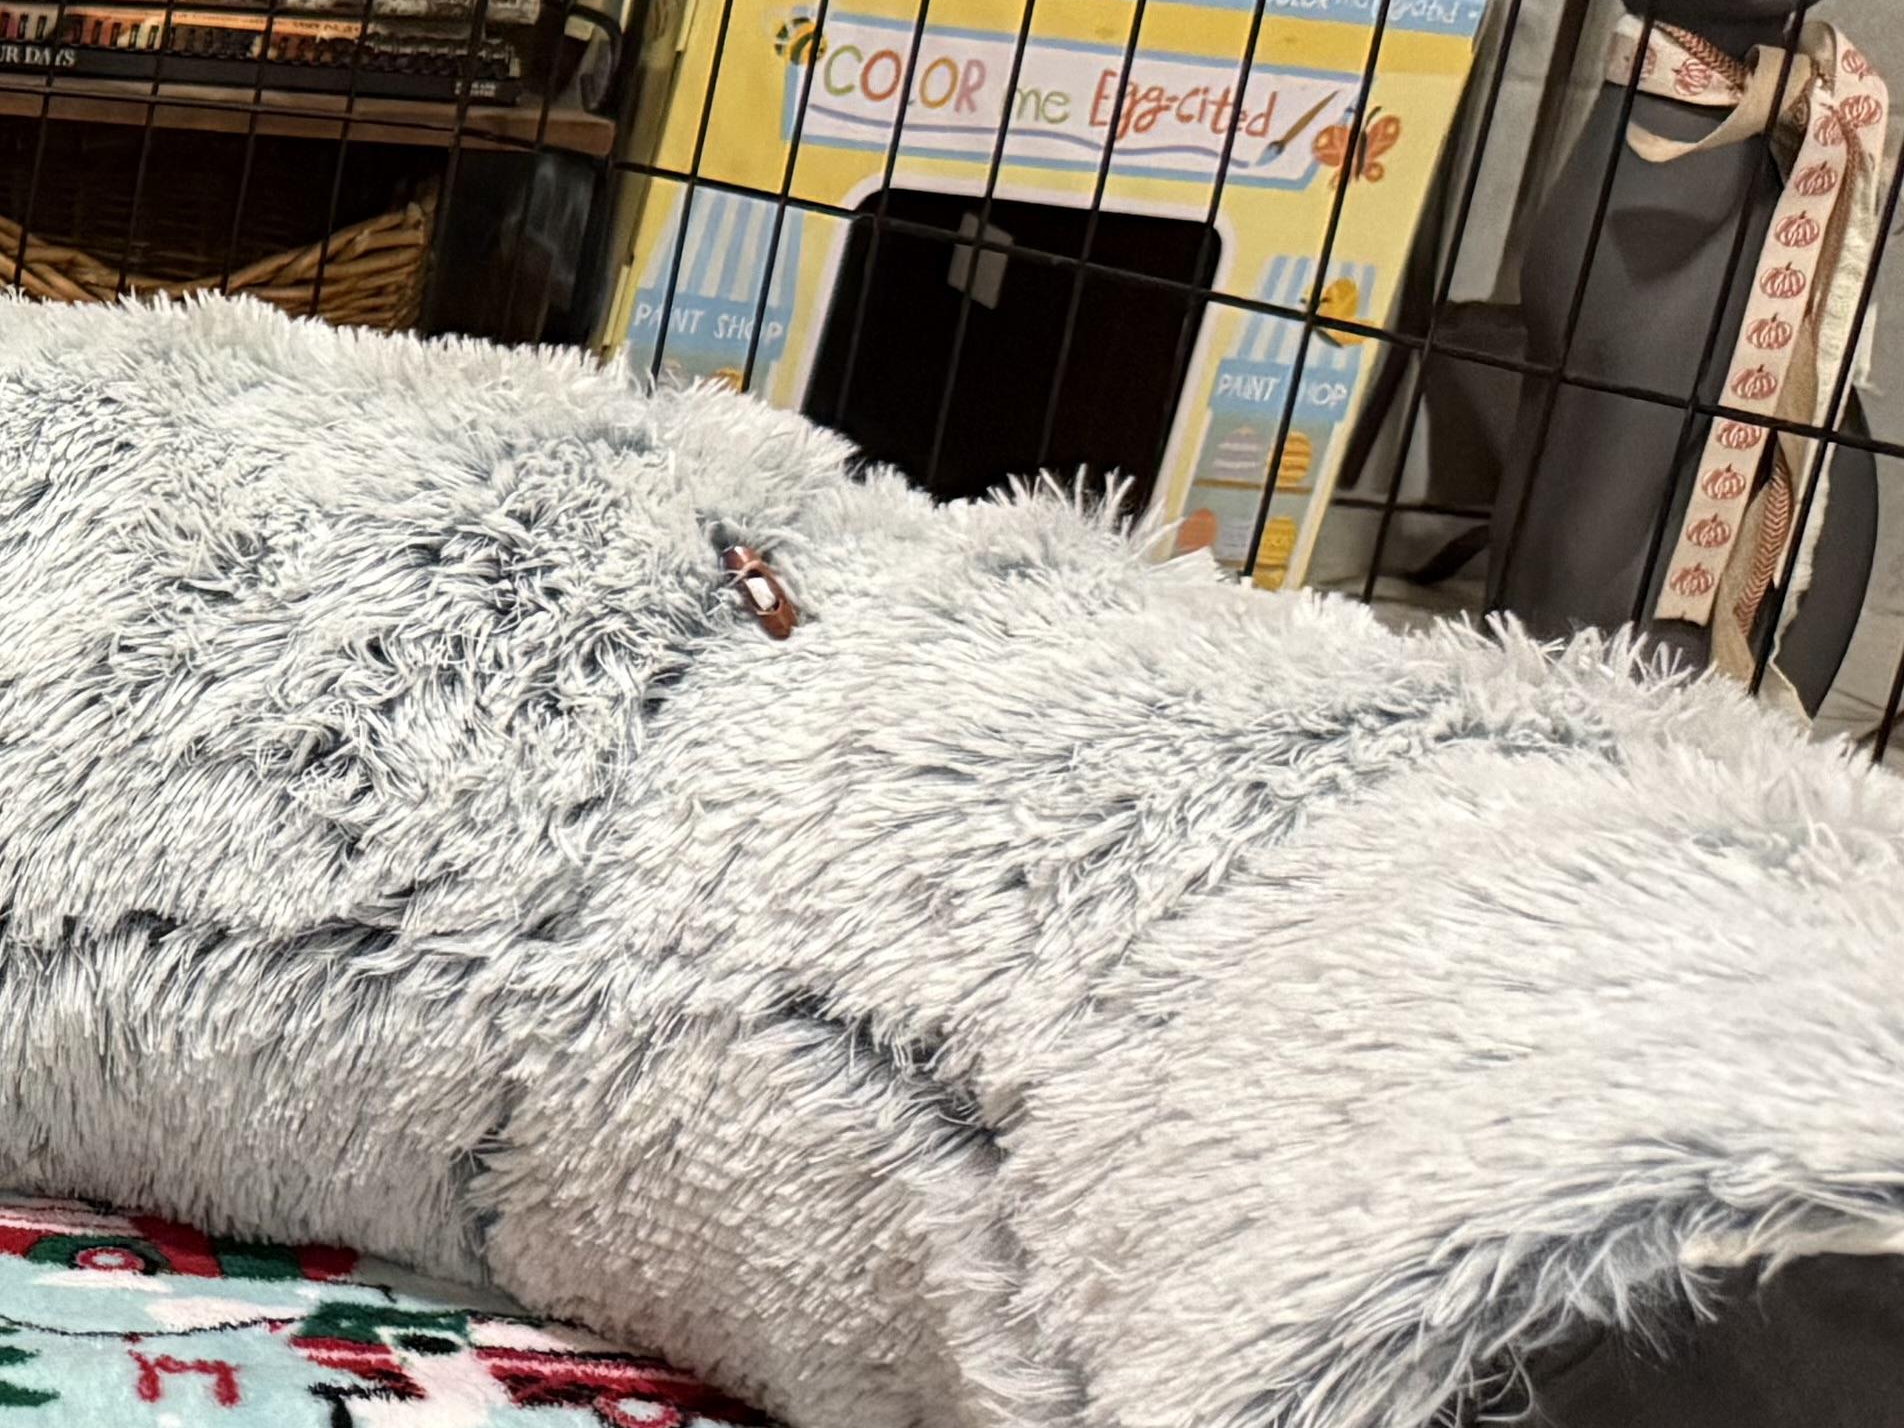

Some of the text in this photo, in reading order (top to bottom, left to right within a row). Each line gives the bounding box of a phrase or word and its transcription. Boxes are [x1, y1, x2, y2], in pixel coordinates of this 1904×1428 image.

[822, 43, 987, 114] COOR
[633, 302, 706, 335] PANT
[130, 1350, 240, 1406] joy
